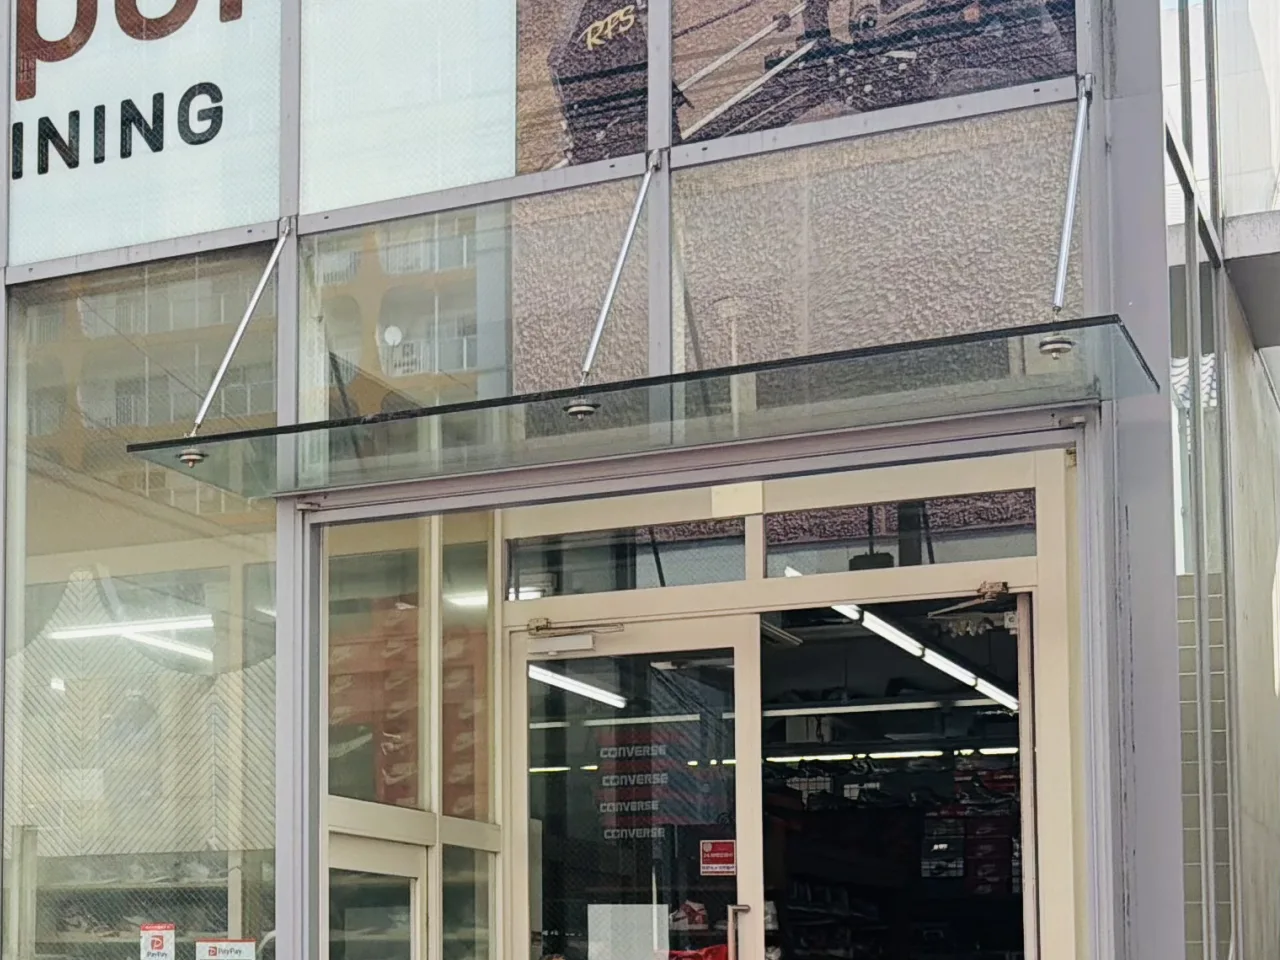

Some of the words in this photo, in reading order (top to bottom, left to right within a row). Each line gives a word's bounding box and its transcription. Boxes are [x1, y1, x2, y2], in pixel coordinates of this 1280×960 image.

[600, 744, 667, 758] CONVERSE
[602, 772, 669, 787] CONVERSE
[600, 800, 659, 813] CONVERSE
[603, 827, 666, 839] CONVERSE
[147, 951, 168, 959] PayPay
[218, 947, 242, 956] PayPay
